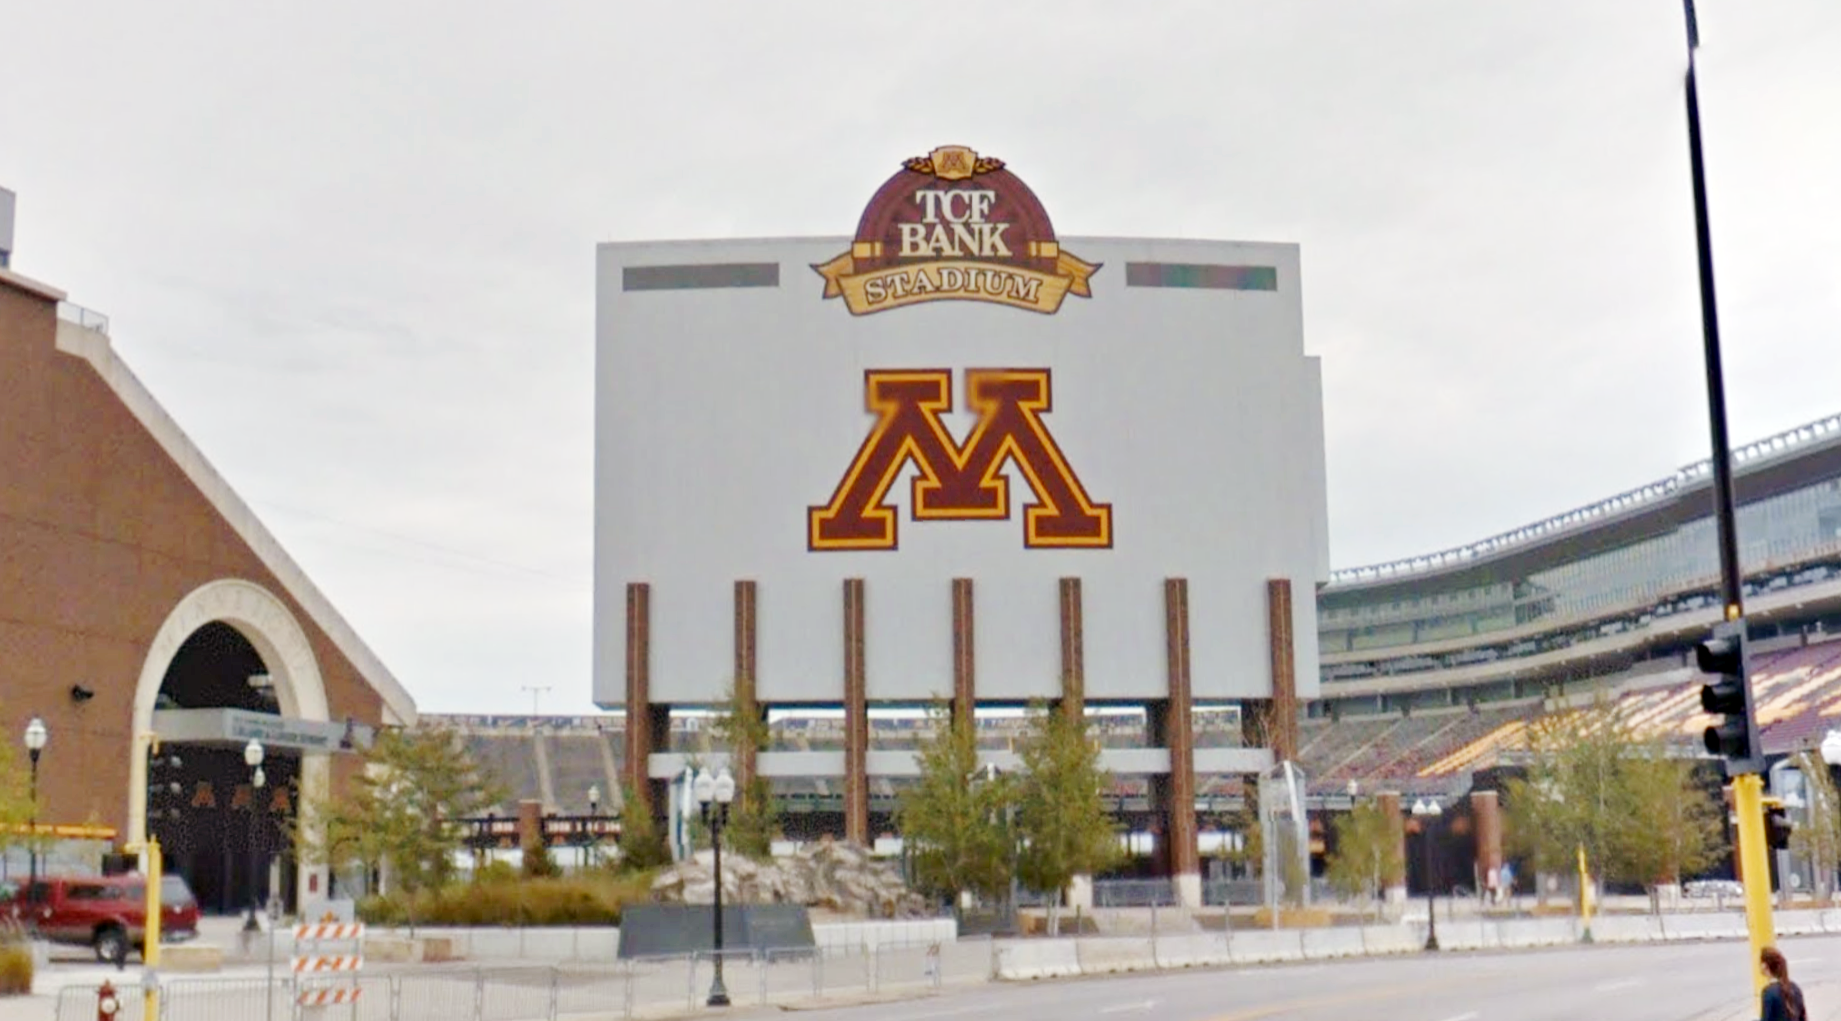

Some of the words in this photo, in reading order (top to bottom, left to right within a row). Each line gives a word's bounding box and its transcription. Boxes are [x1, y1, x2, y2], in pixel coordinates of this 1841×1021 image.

[915, 190, 995, 223] TCF
[898, 223, 1013, 257] BANK
[863, 267, 1043, 304] STADIUM
[807, 369, 1113, 551] M
